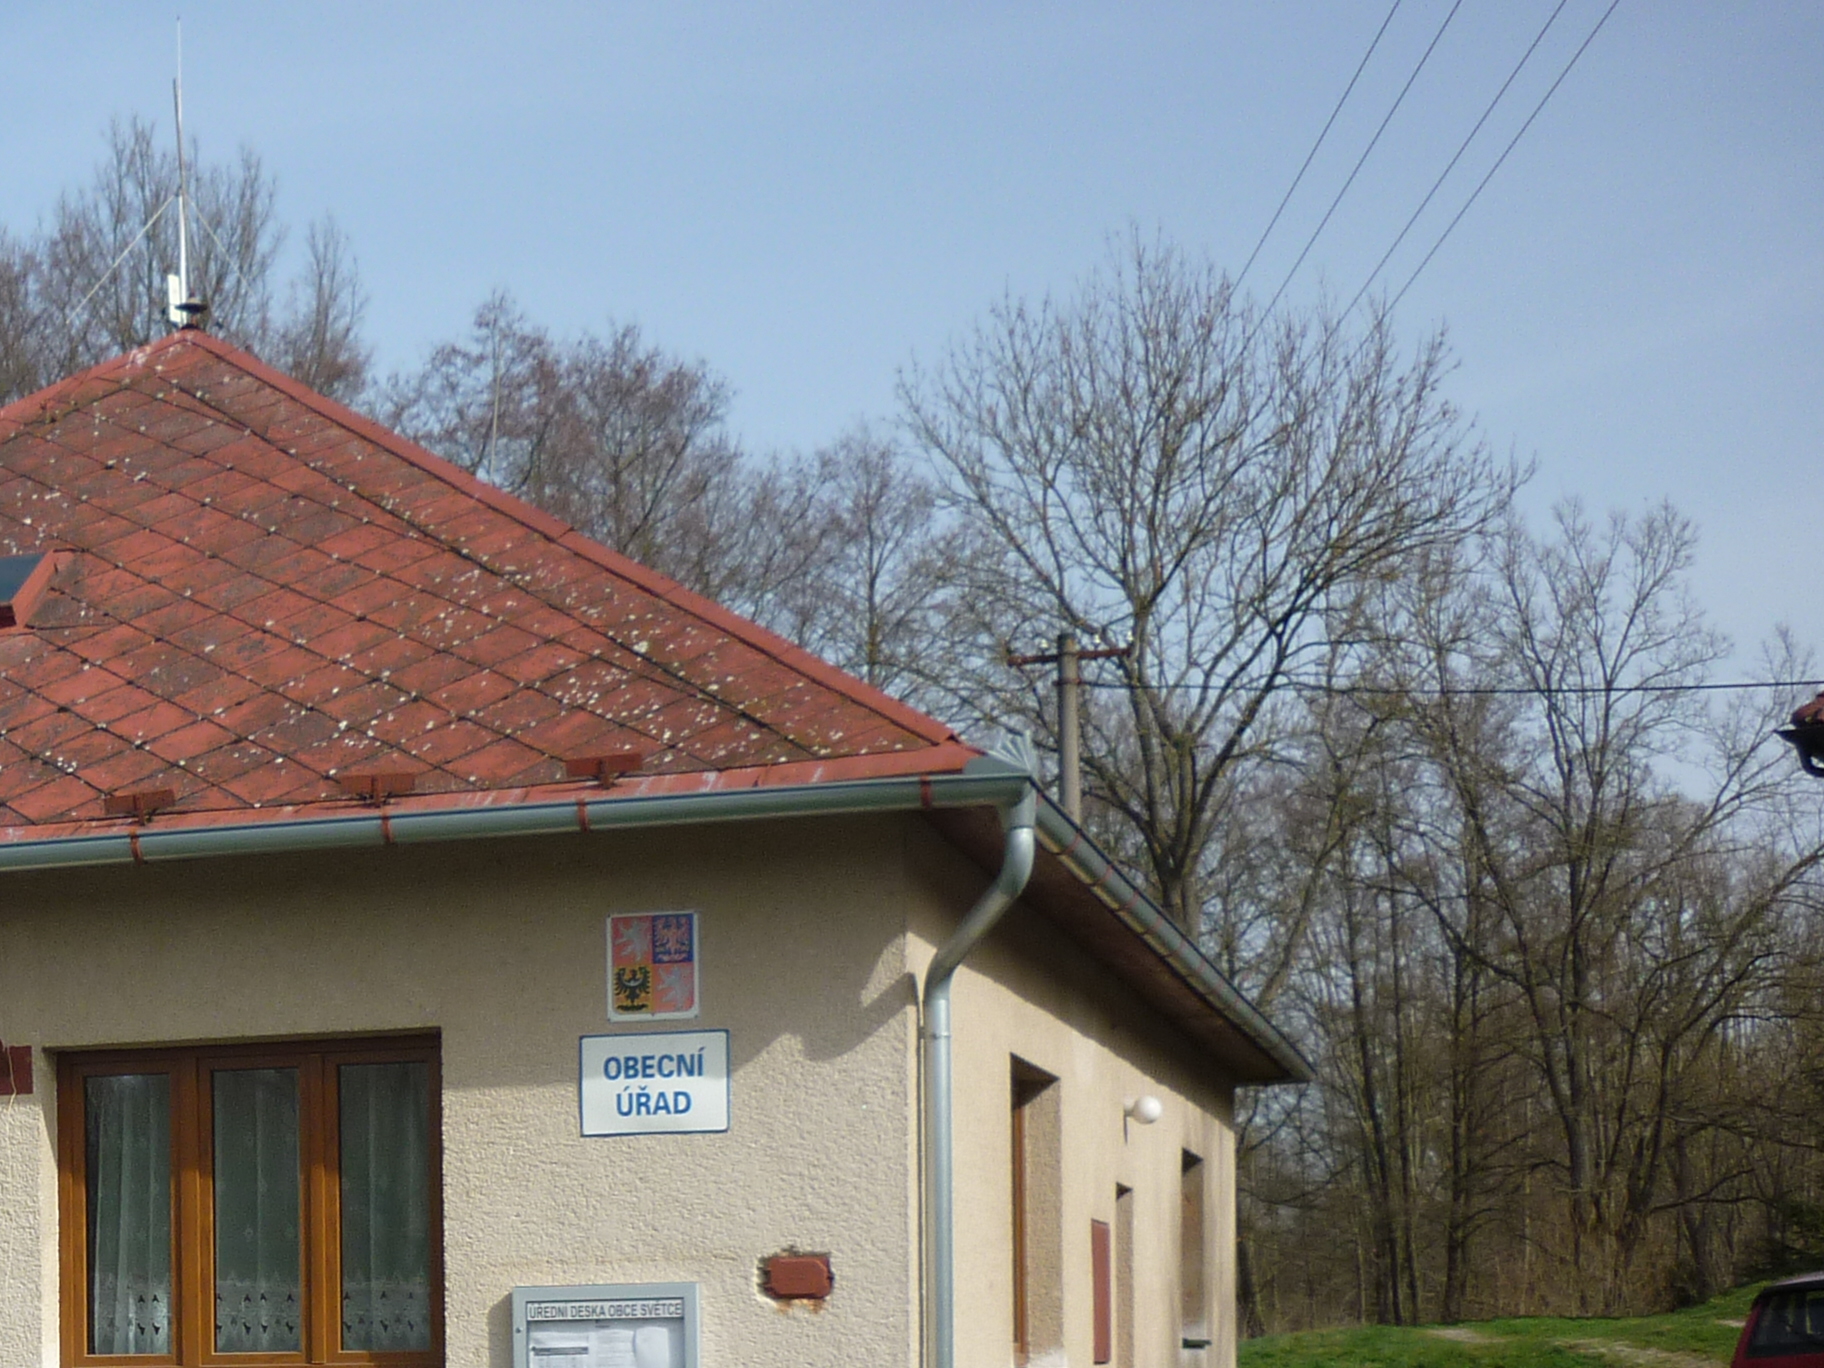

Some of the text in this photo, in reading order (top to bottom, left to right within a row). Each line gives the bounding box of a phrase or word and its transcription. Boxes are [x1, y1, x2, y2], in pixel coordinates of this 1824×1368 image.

[603, 1046, 706, 1081] OBECNÍ
[616, 1085, 692, 1117] ÚŘAD
[570, 1304, 606, 1318] DESKA
[608, 1303, 638, 1317] OBCE
